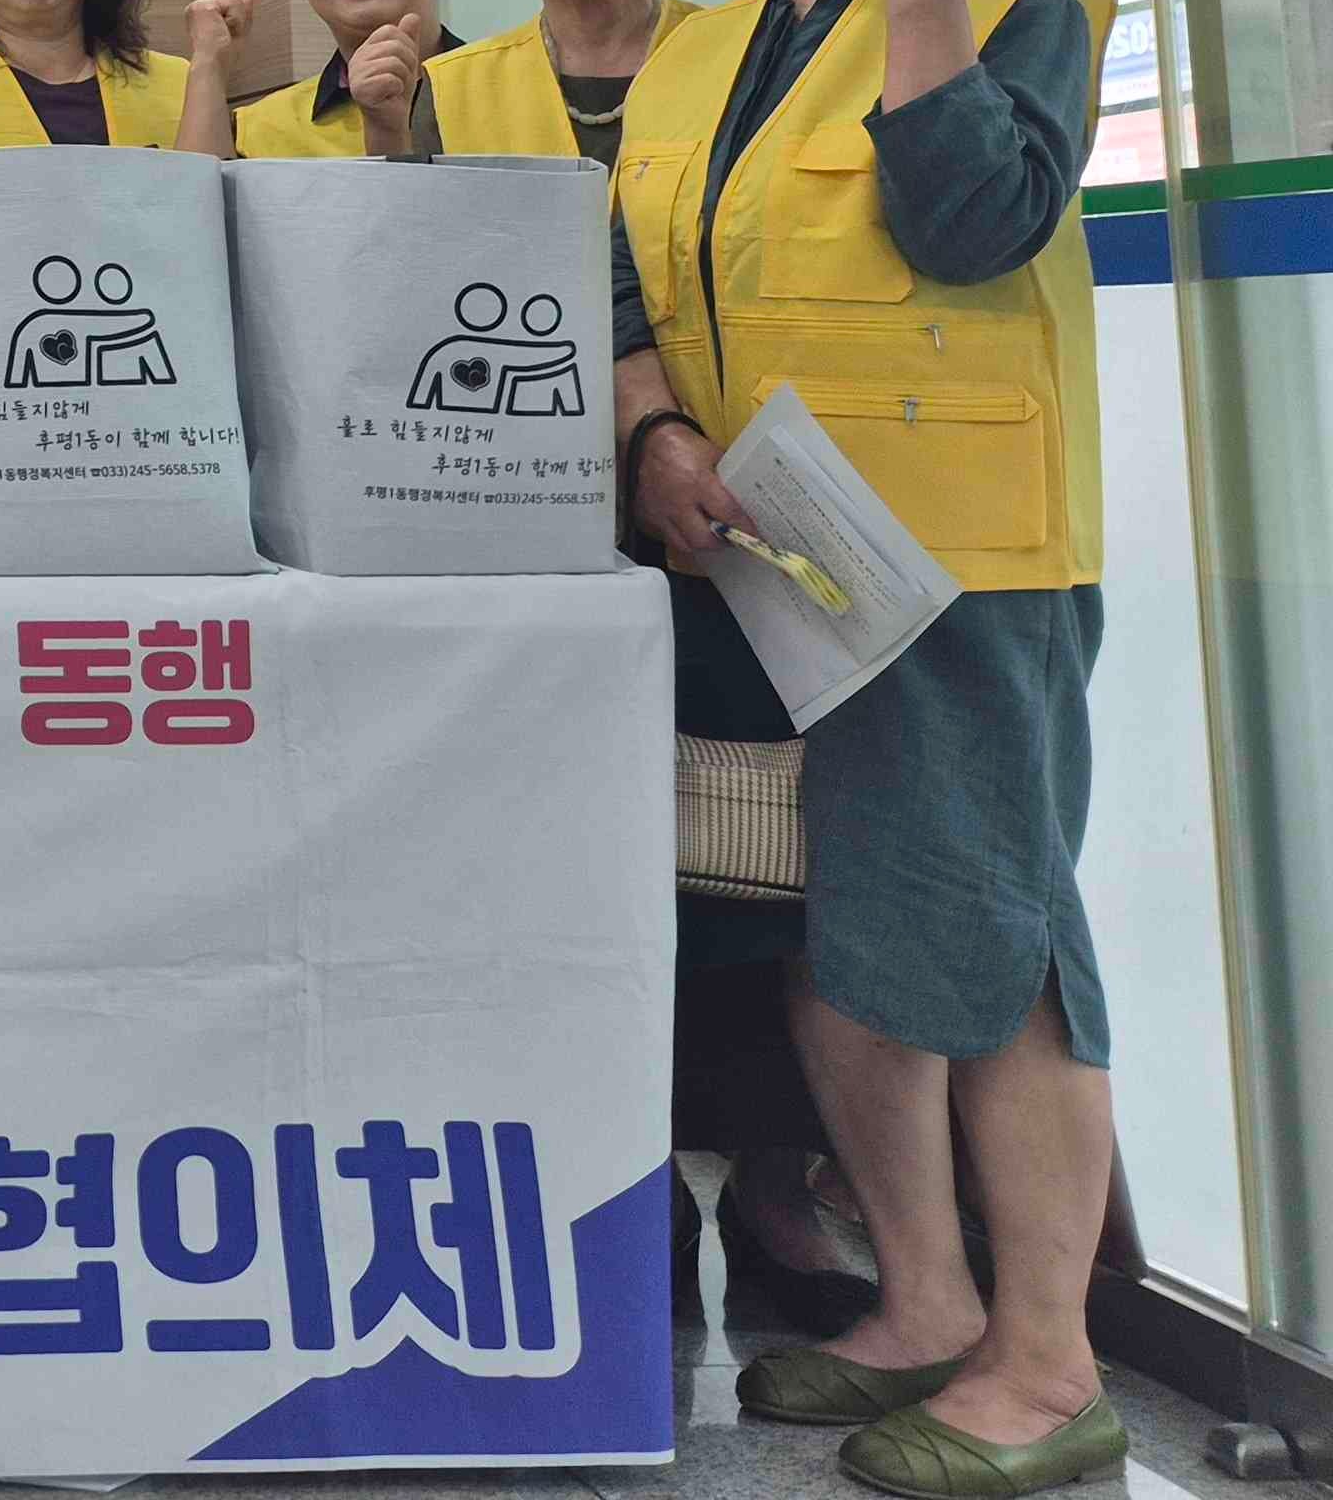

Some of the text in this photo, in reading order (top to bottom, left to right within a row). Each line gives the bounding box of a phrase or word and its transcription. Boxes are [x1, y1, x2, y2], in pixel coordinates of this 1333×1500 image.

[34, 426, 240, 453] 후평1동이 함께 합니다!
[336, 414, 494, 445] 홀로 힘들지않게
[431, 452, 521, 478] 후평1동이
[531, 457, 569, 479] 함께
[363, 485, 481, 505] 후평1동행정복지센터
[17, 619, 255, 746] 동행
